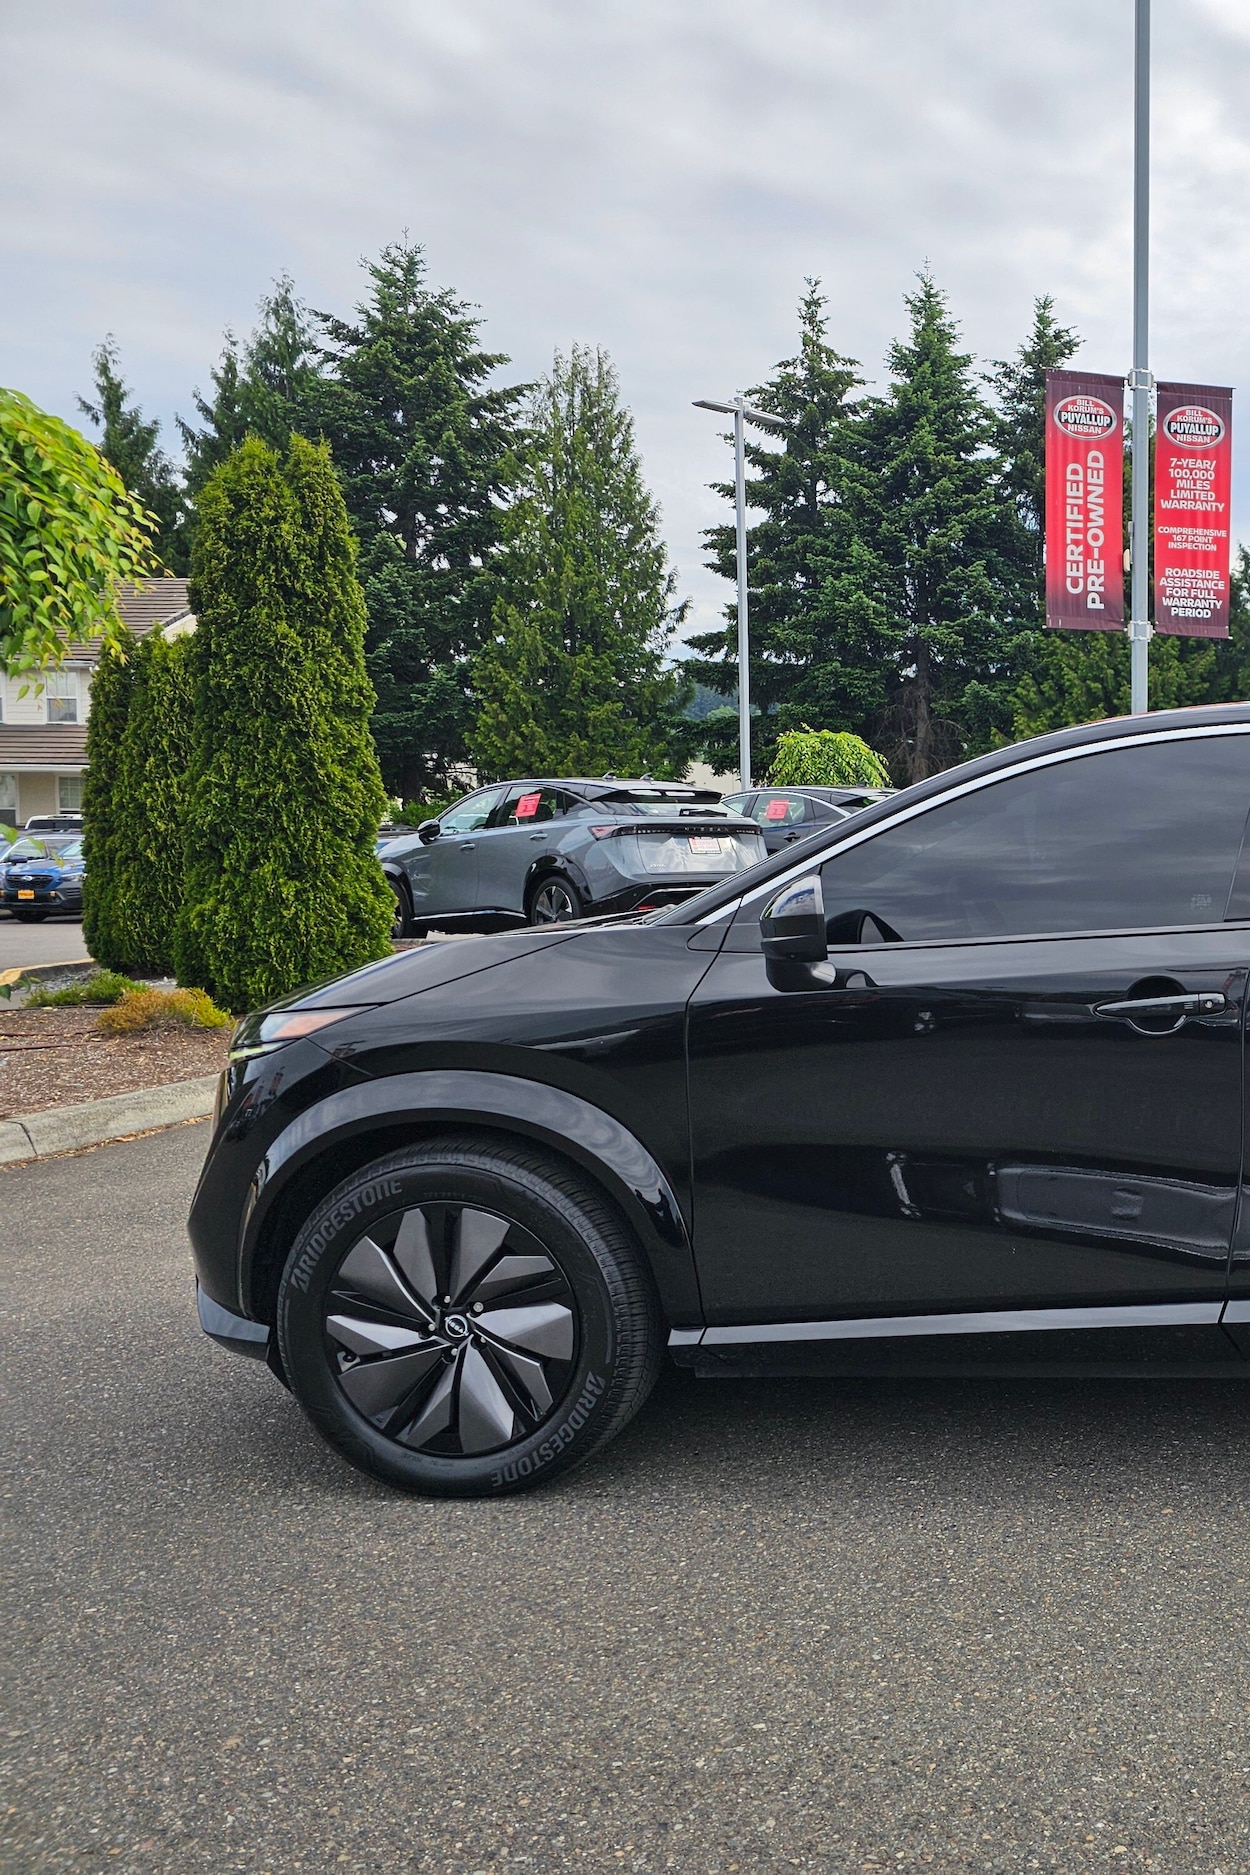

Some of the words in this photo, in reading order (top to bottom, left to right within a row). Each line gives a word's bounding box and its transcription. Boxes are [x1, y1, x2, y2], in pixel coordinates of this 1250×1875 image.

[1076, 399, 1094, 407] BILL
[1067, 404, 1105, 415] KORUM'S
[1185, 409, 1203, 417] BILL
[1060, 411, 1111, 427] PUYALLUP
[1176, 415, 1213, 424] KORUM'S
[1067, 424, 1102, 434] NISSAN
[1170, 422, 1219, 436] PUYALLUP
[1176, 434, 1210, 443] NISSAN
[1170, 457, 1216, 471] 7-YEAR/
[1168, 468, 1215, 480] 100,000
[1176, 479, 1210, 490] MILES
[1170, 489, 1216, 501] LIMITED
[1160, 499, 1225, 513] WARRANTY
[1066, 462, 1084, 595] CERTIFIED
[1087, 450, 1105, 610] PRE-OWNED
[1158, 526, 1227, 537] COMPREHENSIVE
[1172, 534, 1187, 542] 167
[1188, 535, 1213, 544] POINT
[1168, 541, 1217, 551] INSPECTION
[1165, 567, 1220, 579] ROADSIDE
[1159, 577, 1225, 590] ASSISTANCE
[1166, 587, 1189, 597] FOR
[1190, 588, 1217, 599] FULL
[1162, 596, 1223, 610] WARRANTY
[1171, 607, 1212, 619] PERIOD
[290, 1177, 403, 1294] BRIDGESTONE
[492, 1370, 606, 1488] BRIDGESTONE
